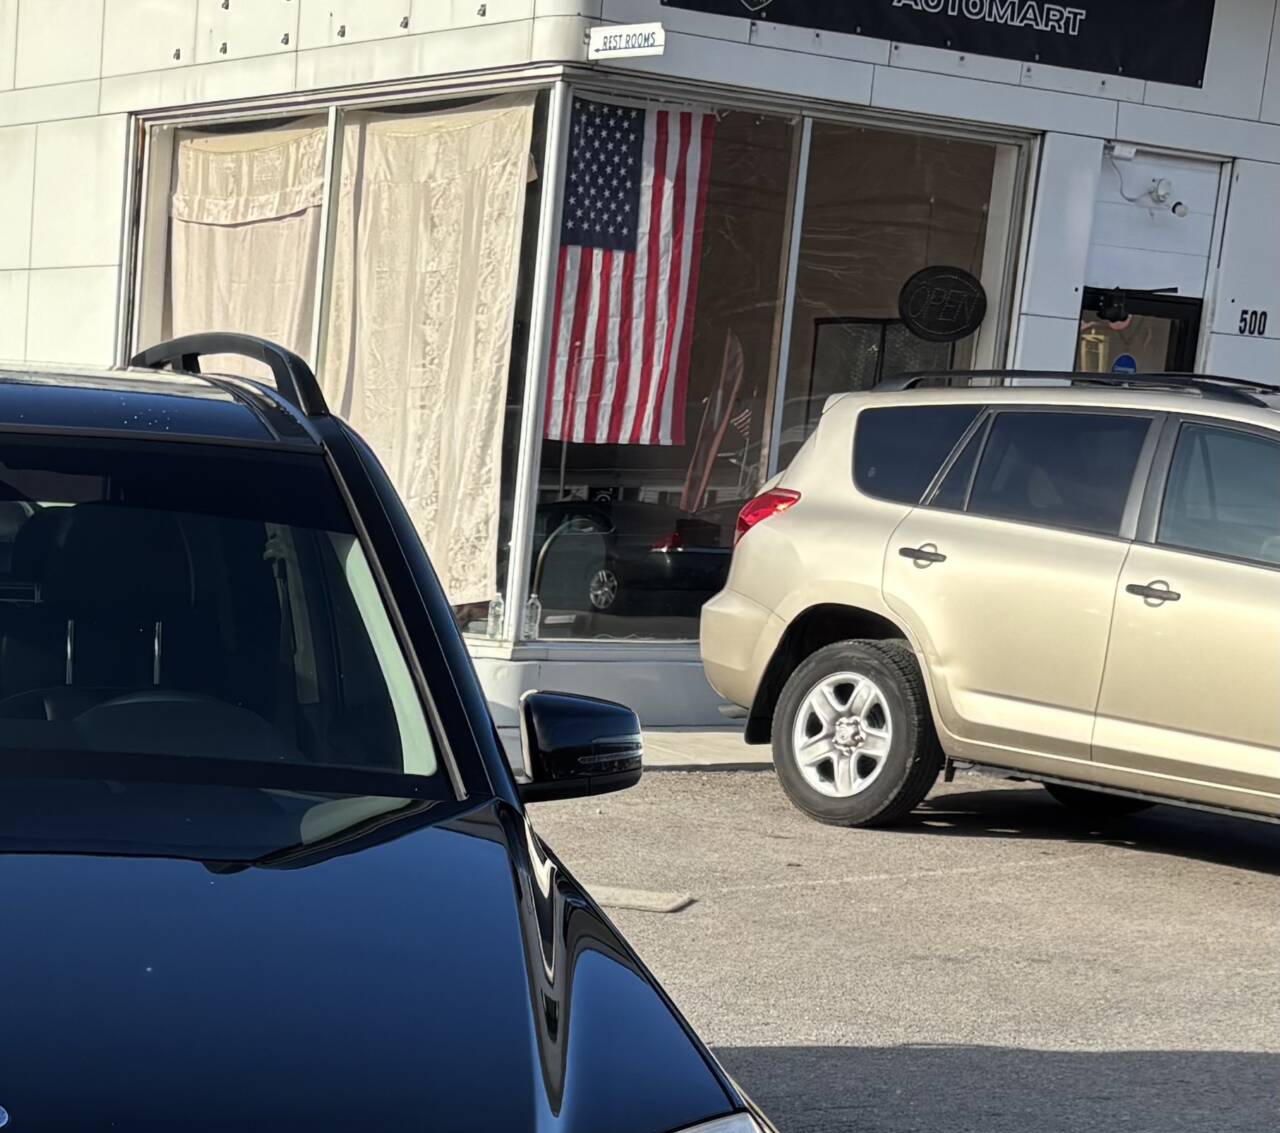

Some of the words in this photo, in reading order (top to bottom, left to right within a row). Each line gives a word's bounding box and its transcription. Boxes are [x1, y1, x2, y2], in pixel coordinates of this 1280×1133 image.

[893, 0, 1086, 35] TOMART
[603, 34, 623, 50] REST
[625, 31, 656, 48] ROOMS
[1238, 309, 1268, 336] 500
